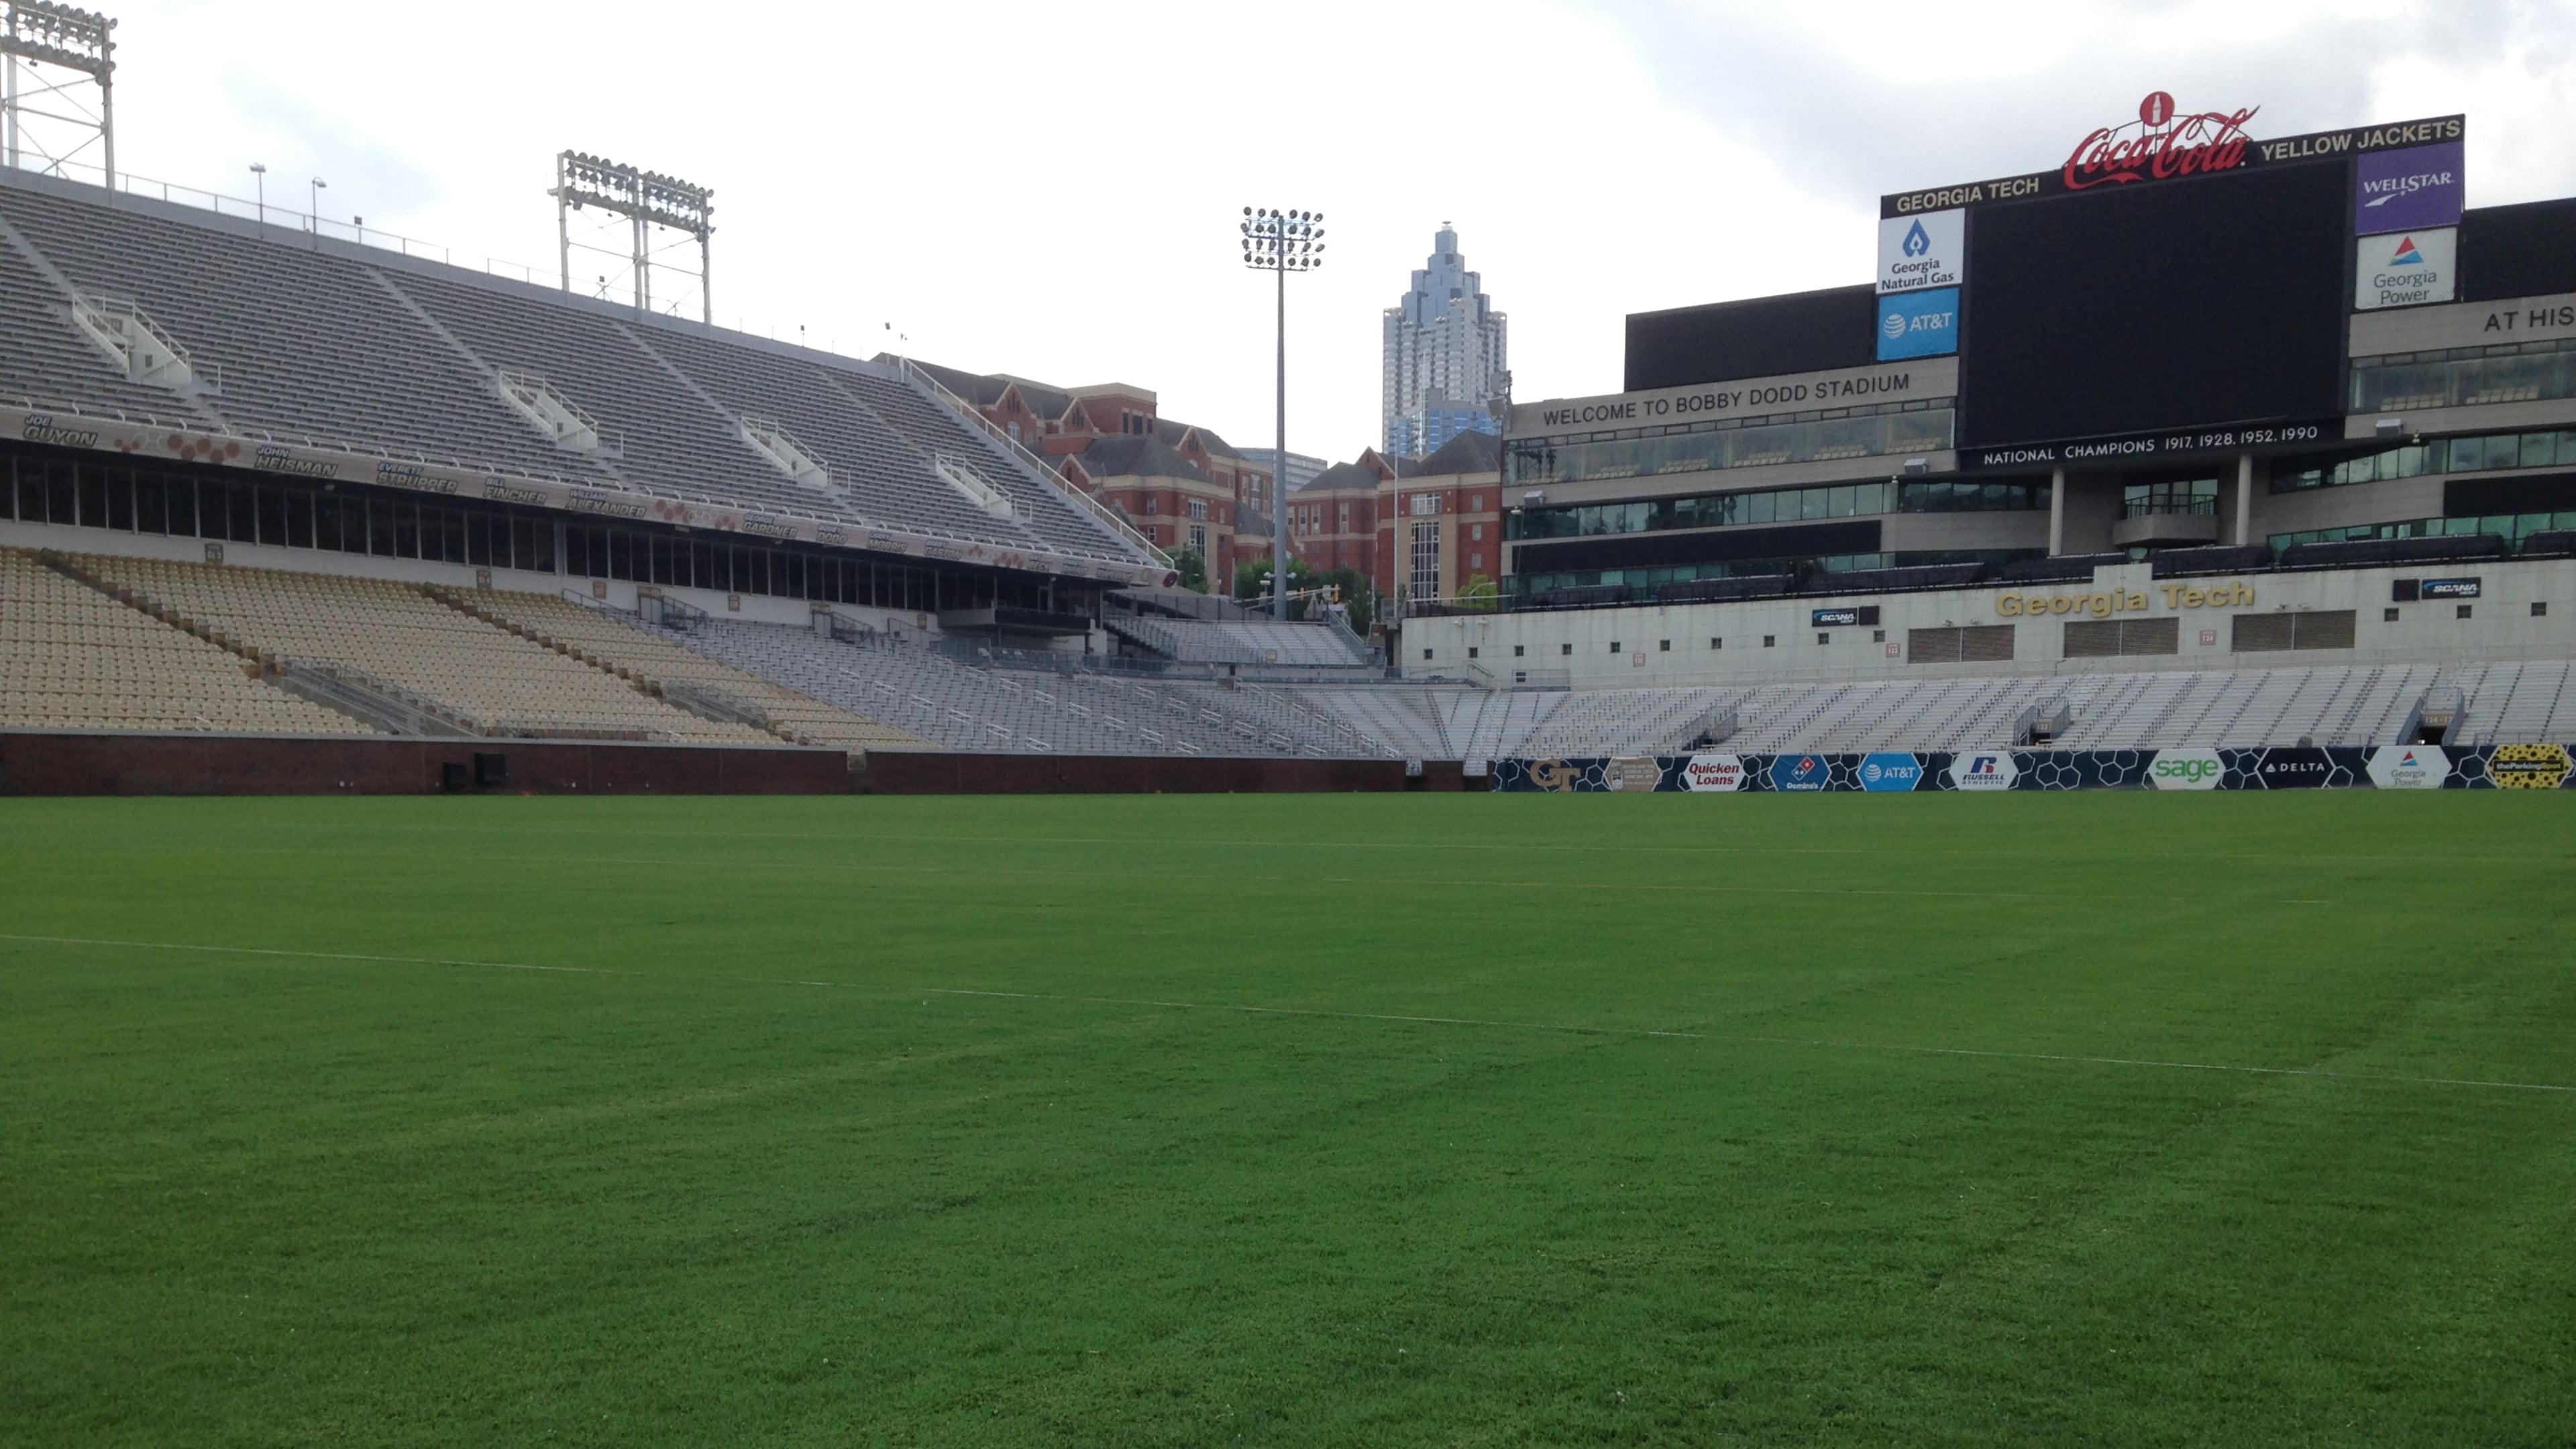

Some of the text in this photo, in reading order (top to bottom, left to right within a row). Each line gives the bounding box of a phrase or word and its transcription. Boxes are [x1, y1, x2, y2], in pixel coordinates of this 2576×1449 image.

[2063, 105, 2260, 189] Coca-Cola
[2261, 119, 2461, 161] YELLOW JACKETS
[2363, 172, 2451, 193] WELLSTAR
[1897, 178, 2039, 212] GEORGIA TECH
[1892, 258, 1940, 274] Georgia
[1882, 272, 1954, 290] Natural Gas
[2374, 270, 2436, 288] Georgia
[2381, 289, 2429, 304] Power
[1909, 313, 1953, 331] AT&T
[2484, 306, 2575, 331] AT HIS
[1544, 374, 1909, 425] WELCOME TO BOBBY DODD STADIUM
[25, 415, 52, 427] JOE
[23, 425, 97, 446] GUYON
[257, 445, 290, 458] JOHN
[1984, 448, 2055, 464] NATIONAL
[2065, 439, 2155, 458] CHAMPIONS
[2282, 426, 2318, 440] 1990
[256, 456, 337, 477] HEISMAN
[483, 486, 547, 504] FINCHER
[566, 498, 647, 519] ALEXANDER
[2433, 583, 2477, 593] SCANA
[1996, 581, 2255, 618] Georgia Tech
[1820, 613, 1854, 622] SCANA
[1530, 759, 1580, 792] GT
[1689, 763, 1739, 774] Quicken
[1884, 767, 1915, 778] AT&T
[2155, 759, 2218, 782] sage
[2279, 763, 2325, 771] DELTA
[2391, 769, 2426, 779] Georgia
[1697, 774, 1734, 785] Loans
[2395, 778, 2422, 786] Power
